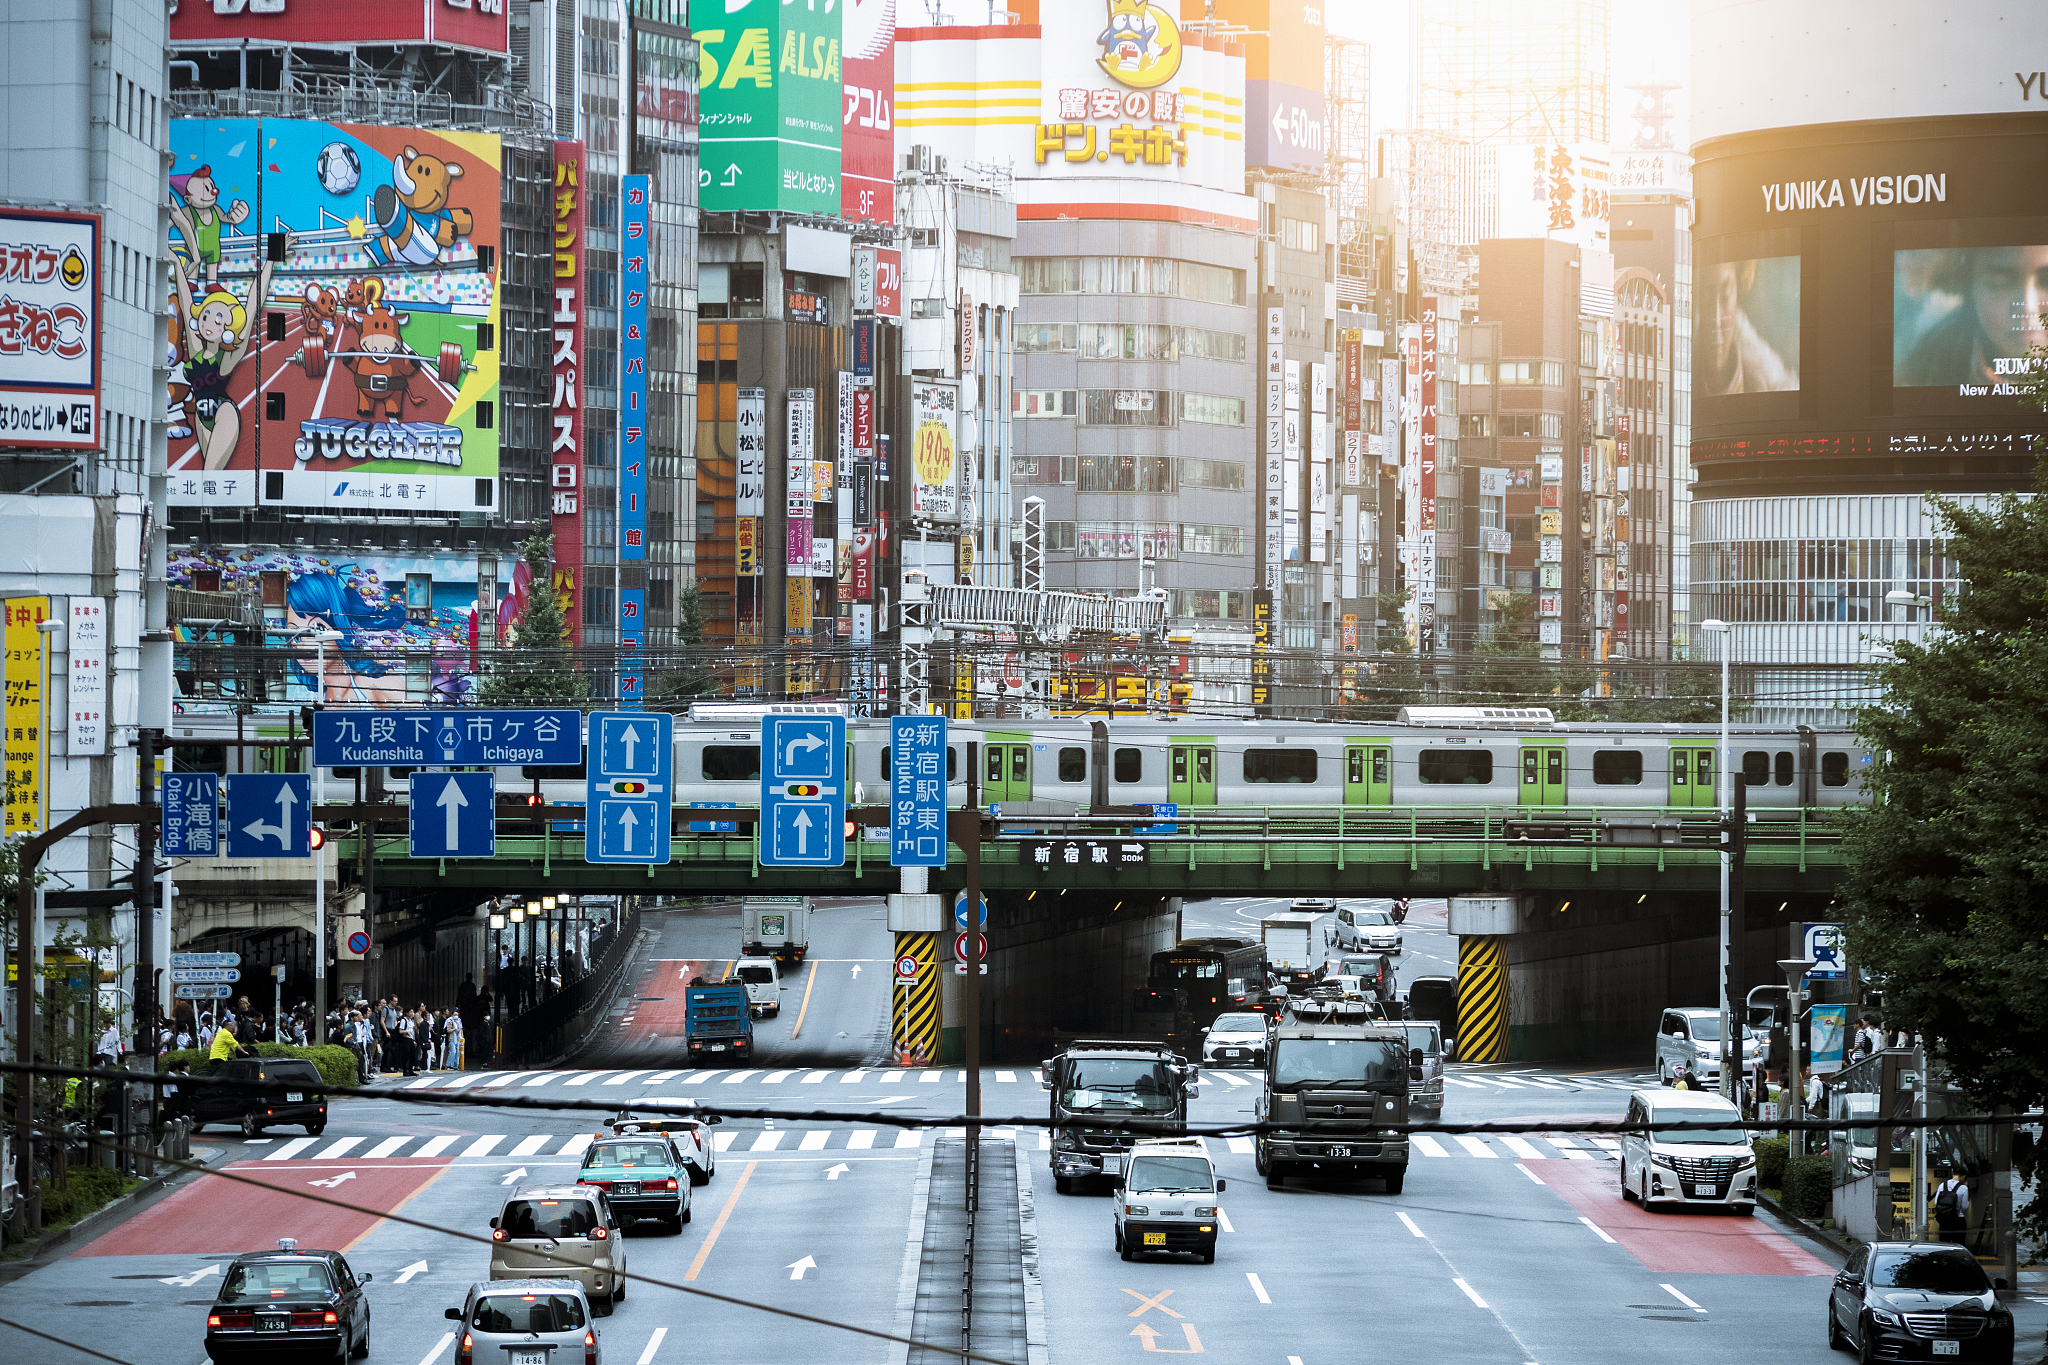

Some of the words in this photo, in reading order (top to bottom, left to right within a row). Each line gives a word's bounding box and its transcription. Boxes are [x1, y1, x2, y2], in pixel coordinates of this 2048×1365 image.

[1302, 5, 1322, 27] プロミス
[779, 29, 840, 83] ALSA
[843, 84, 891, 131] アコム
[1059, 88, 1185, 123] 驚安の殿堂
[1290, 107, 1321, 151] 50m
[1622, 156, 1665, 169] 水の森
[783, 168, 828, 194] 当ビルとなり
[1548, 144, 1575, 229] 東海苑
[1762, 179, 1845, 213] YUNIKA
[1850, 173, 1946, 206] VISION
[859, 190, 875, 216] 3F
[555, 157, 579, 278] パチンコ
[858, 254, 871, 305] 戸谷ビル
[859, 325, 868, 364] PROMISE
[1347, 330, 1359, 340] 8F
[1422, 309, 1436, 383] カラオケ
[1960, 384, 1989, 396] New
[72, 407, 89, 433] 4F
[858, 405, 869, 447] アイフル
[295, 420, 464, 467] JUGGLER
[919, 429, 951, 468] 190円
[1422, 404, 1436, 474] パセラ
[739, 409, 755, 500] 小松ビル
[182, 480, 238, 496] 北電子
[349, 488, 375, 498] 株式会社
[379, 483, 427, 499] 北電子
[857, 558, 867, 588] アコム
[1422, 534, 1435, 589] パーティー
[837, 587, 852, 599] たばこ
[857, 589, 866, 597] 3F
[74, 606, 99, 616] 営業中
[841, 603, 848, 616] 酒
[76, 631, 98, 641] スーパー
[78, 621, 95, 631] メガネ
[74, 659, 99, 669] 営業中
[73, 684, 100, 694] レンジャー
[75, 674, 97, 683] チケット
[790, 684, 800, 692] 6F
[74, 712, 99, 722] 営業中
[78, 724, 96, 734] 牛かつ
[78, 736, 95, 746] もと村
[334, 716, 432, 744] 九段下
[443, 732, 454, 746] 4
[342, 746, 424, 761] Kudanshita
[483, 745, 544, 762] Ichigaya
[895, 727, 915, 794] Shinjuku
[167, 777, 182, 813] Otaki
[916, 723, 940, 857] 新宿駅東口
[184, 777, 213, 852] 小滝橋
[165, 817, 182, 852] Brdg.
[875, 830, 890, 838] Shin
[1034, 841, 1109, 864] 新宿駅
[1330, 1148, 1351, 1157] 13-38
[264, 1321, 285, 1330] 74-58
[521, 1356, 542, 1365] 14-86
